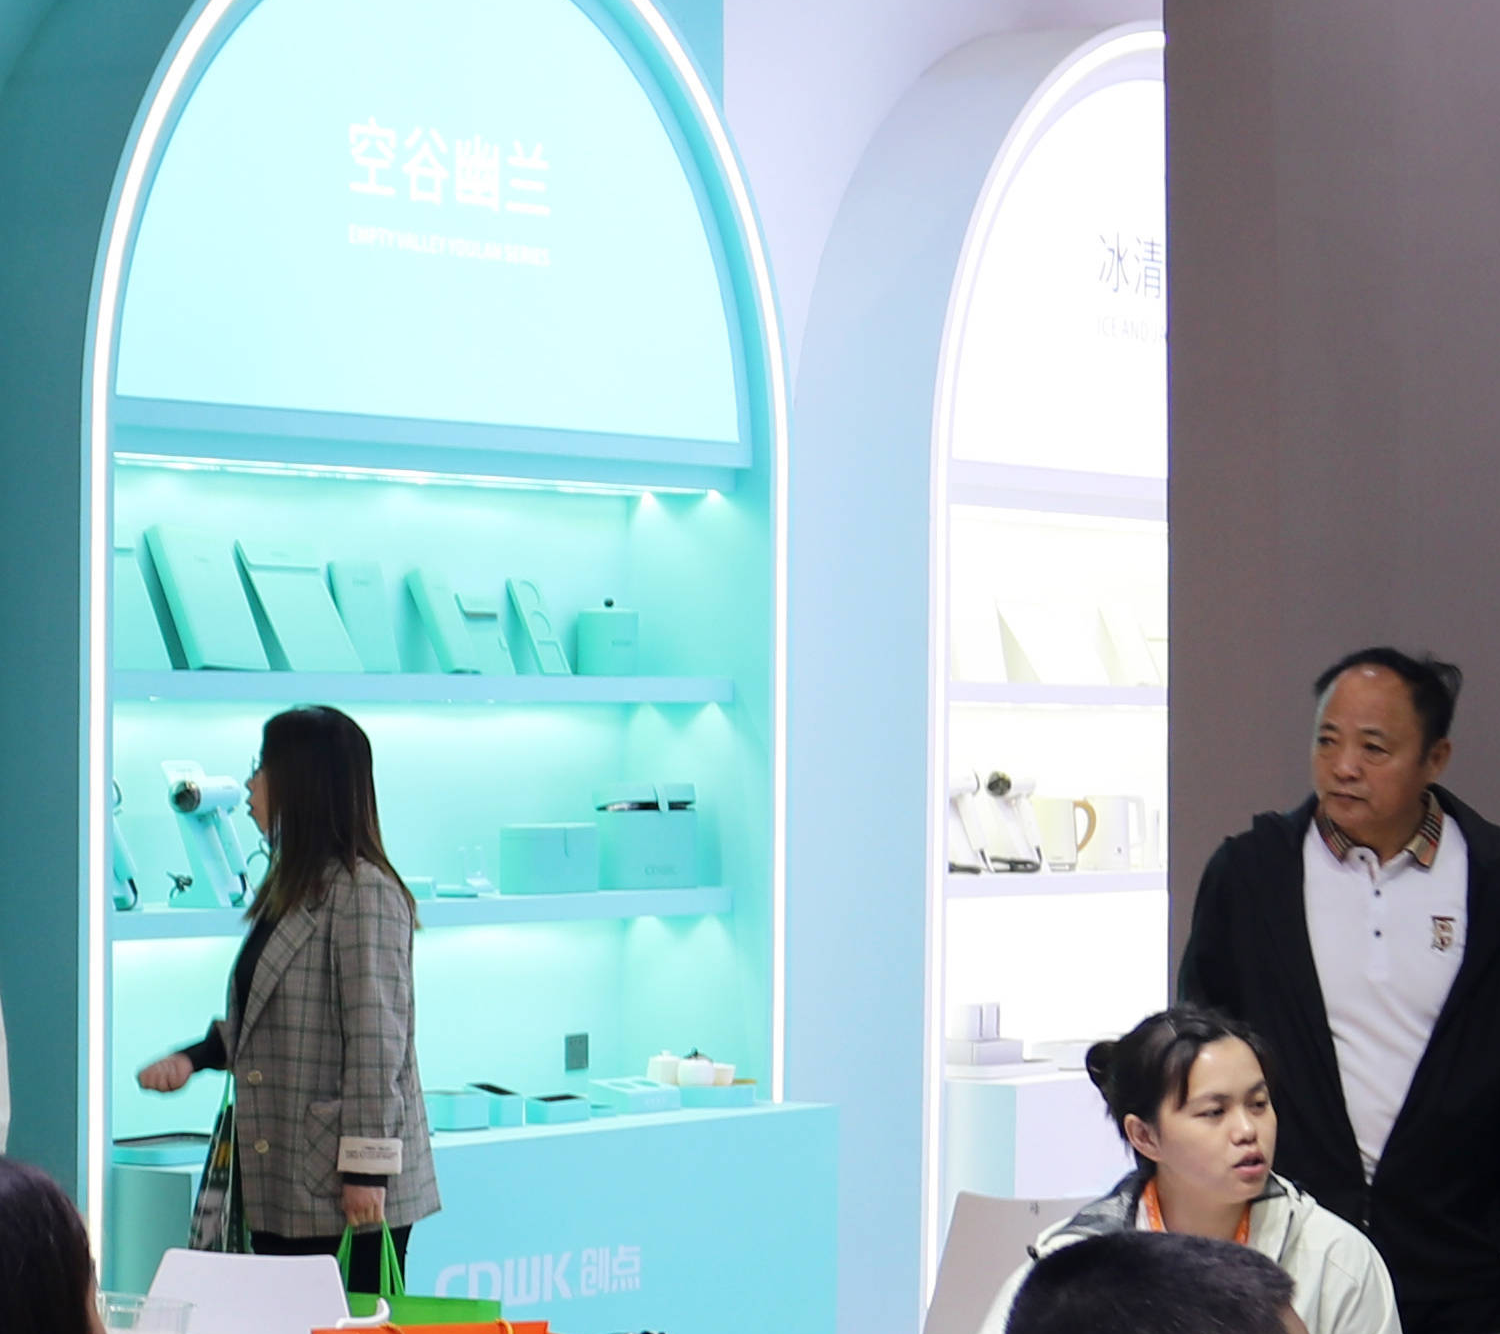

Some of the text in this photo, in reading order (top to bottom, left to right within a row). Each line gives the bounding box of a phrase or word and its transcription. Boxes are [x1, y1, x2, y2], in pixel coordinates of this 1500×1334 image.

[348, 114, 551, 217] 空谷幽兰
[580, 1244, 641, 1297] 创点
